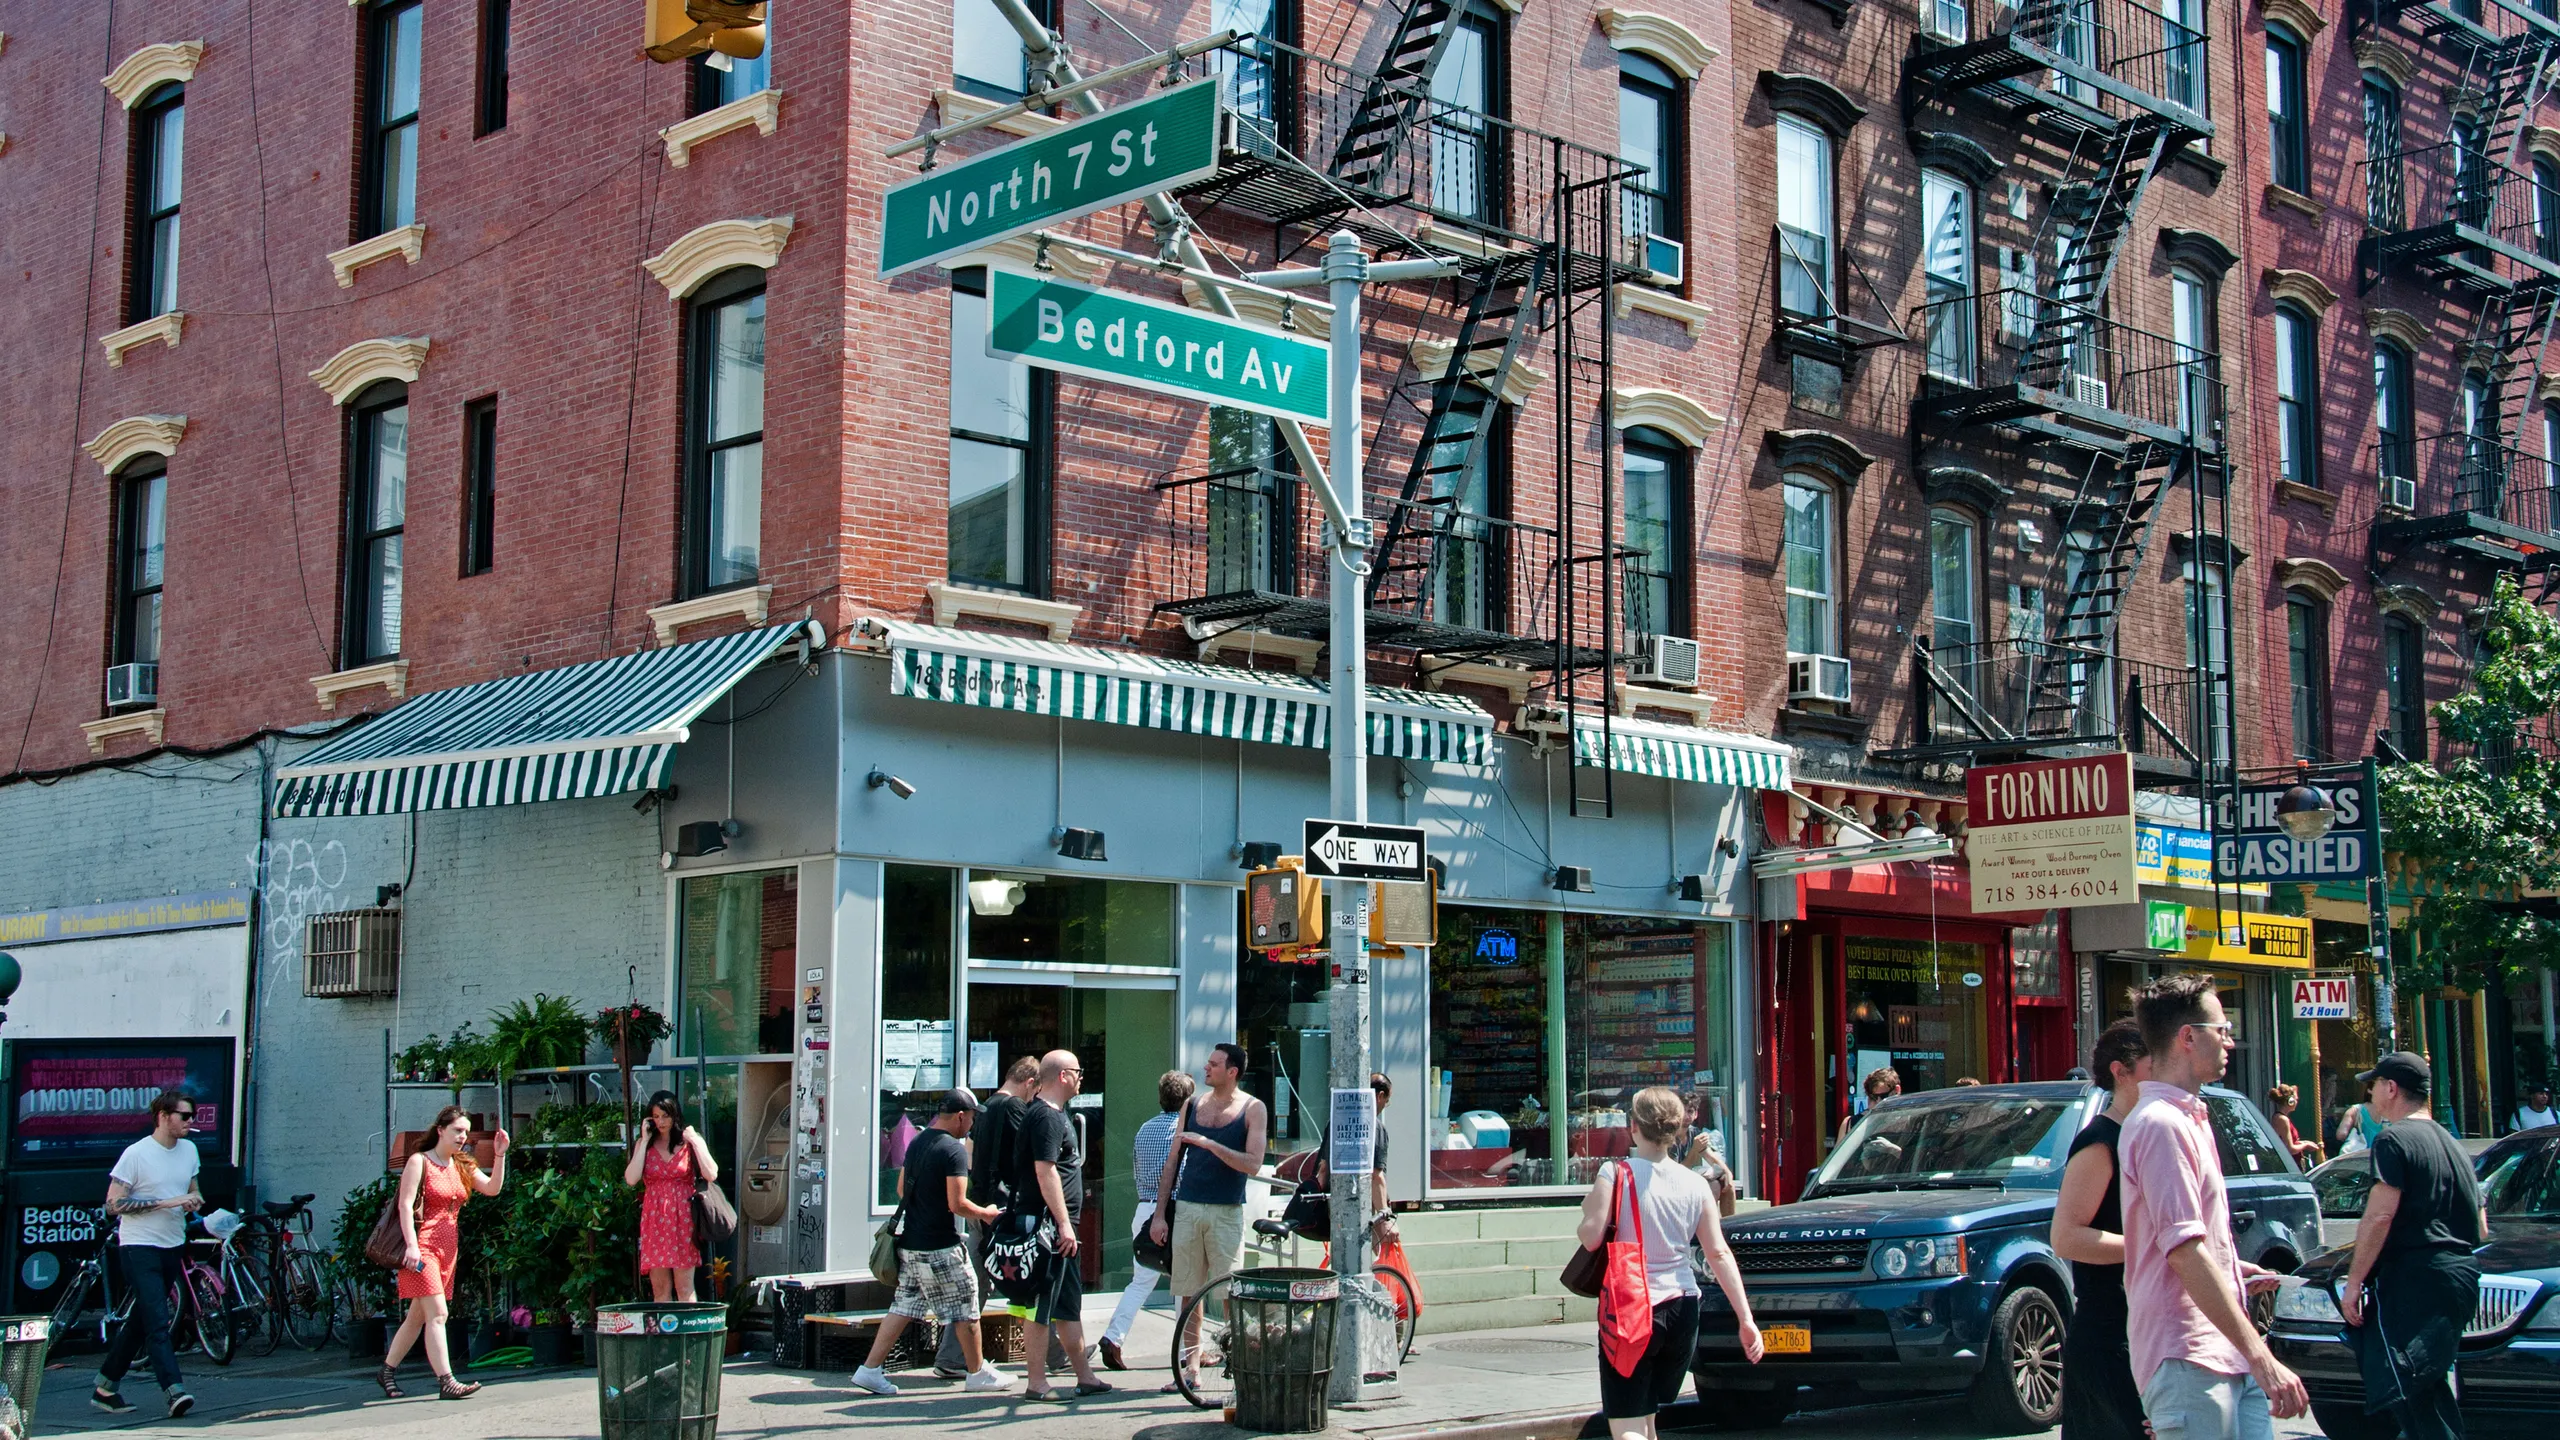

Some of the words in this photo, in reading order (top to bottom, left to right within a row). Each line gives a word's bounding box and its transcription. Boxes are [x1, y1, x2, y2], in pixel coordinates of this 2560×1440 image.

[926, 160, 1052, 239] North
[1067, 141, 1093, 191] 7
[1107, 120, 1159, 178] St
[1037, 298, 1225, 381] Bedford
[1240, 347, 1294, 395] Av
[948, 667, 1010, 696] Bedford
[1013, 677, 1045, 701] Ave.
[1985, 763, 2109, 821] FORNINO
[2217, 786, 2360, 829] CHES
[1977, 833, 1997, 845] THE
[2000, 831, 2023, 844] ART
[2032, 827, 2075, 841] SCIENCE
[2078, 825, 2092, 837] OF
[2095, 823, 2123, 836] PIZZA
[2166, 832, 2212, 851] Financial
[1323, 839, 1358, 862] ONE
[1374, 842, 1410, 865] WAY
[1980, 856, 2005, 868] Award
[2007, 855, 2036, 867] Winning
[2046, 851, 2067, 863] Wood
[2068, 849, 2098, 862] Burning
[2099, 848, 2122, 859] Oven
[2217, 836, 2361, 877] CASHED
[2011, 871, 2029, 880] TAKE
[2031, 870, 2047, 878] OUT
[2048, 869, 2054, 877] &
[2056, 867, 2091, 877] DELIVERY
[2167, 864, 2199, 880] Checks
[1984, 886, 2015, 905] 718
[2025, 879, 2119, 901] 384-6004
[2151, 911, 2184, 940] ATM
[2250, 924, 2299, 942] WESTERN
[1475, 934, 1517, 957] ATM
[1846, 945, 1872, 960] VOTED
[1872, 947, 1891, 961] BEST
[1891, 948, 1912, 963] PIZZA
[2265, 940, 2299, 956] UNION
[1847, 964, 1866, 980] BEST
[1867, 966, 1891, 981] BRICK
[1890, 967, 1911, 983] OVEN
[1912, 969, 1932, 984] PIZZA
[2294, 980, 2348, 1004] ATM
[2300, 1006, 2314, 1017] 24
[2316, 1006, 2344, 1017] Hour
[32, 1071, 73, 1087] WHICH
[76, 1070, 129, 1087] FLANNEL
[133, 1070, 149, 1086] TO
[29, 1088, 36, 1113] I
[39, 1087, 106, 1112] MOVED
[110, 1086, 136, 1110] ON
[23, 1224, 96, 1244] Station
[1730, 1231, 1789, 1241] RANGE
[1800, 1228, 1867, 1239] ROVER
[32, 1260, 49, 1282] L
